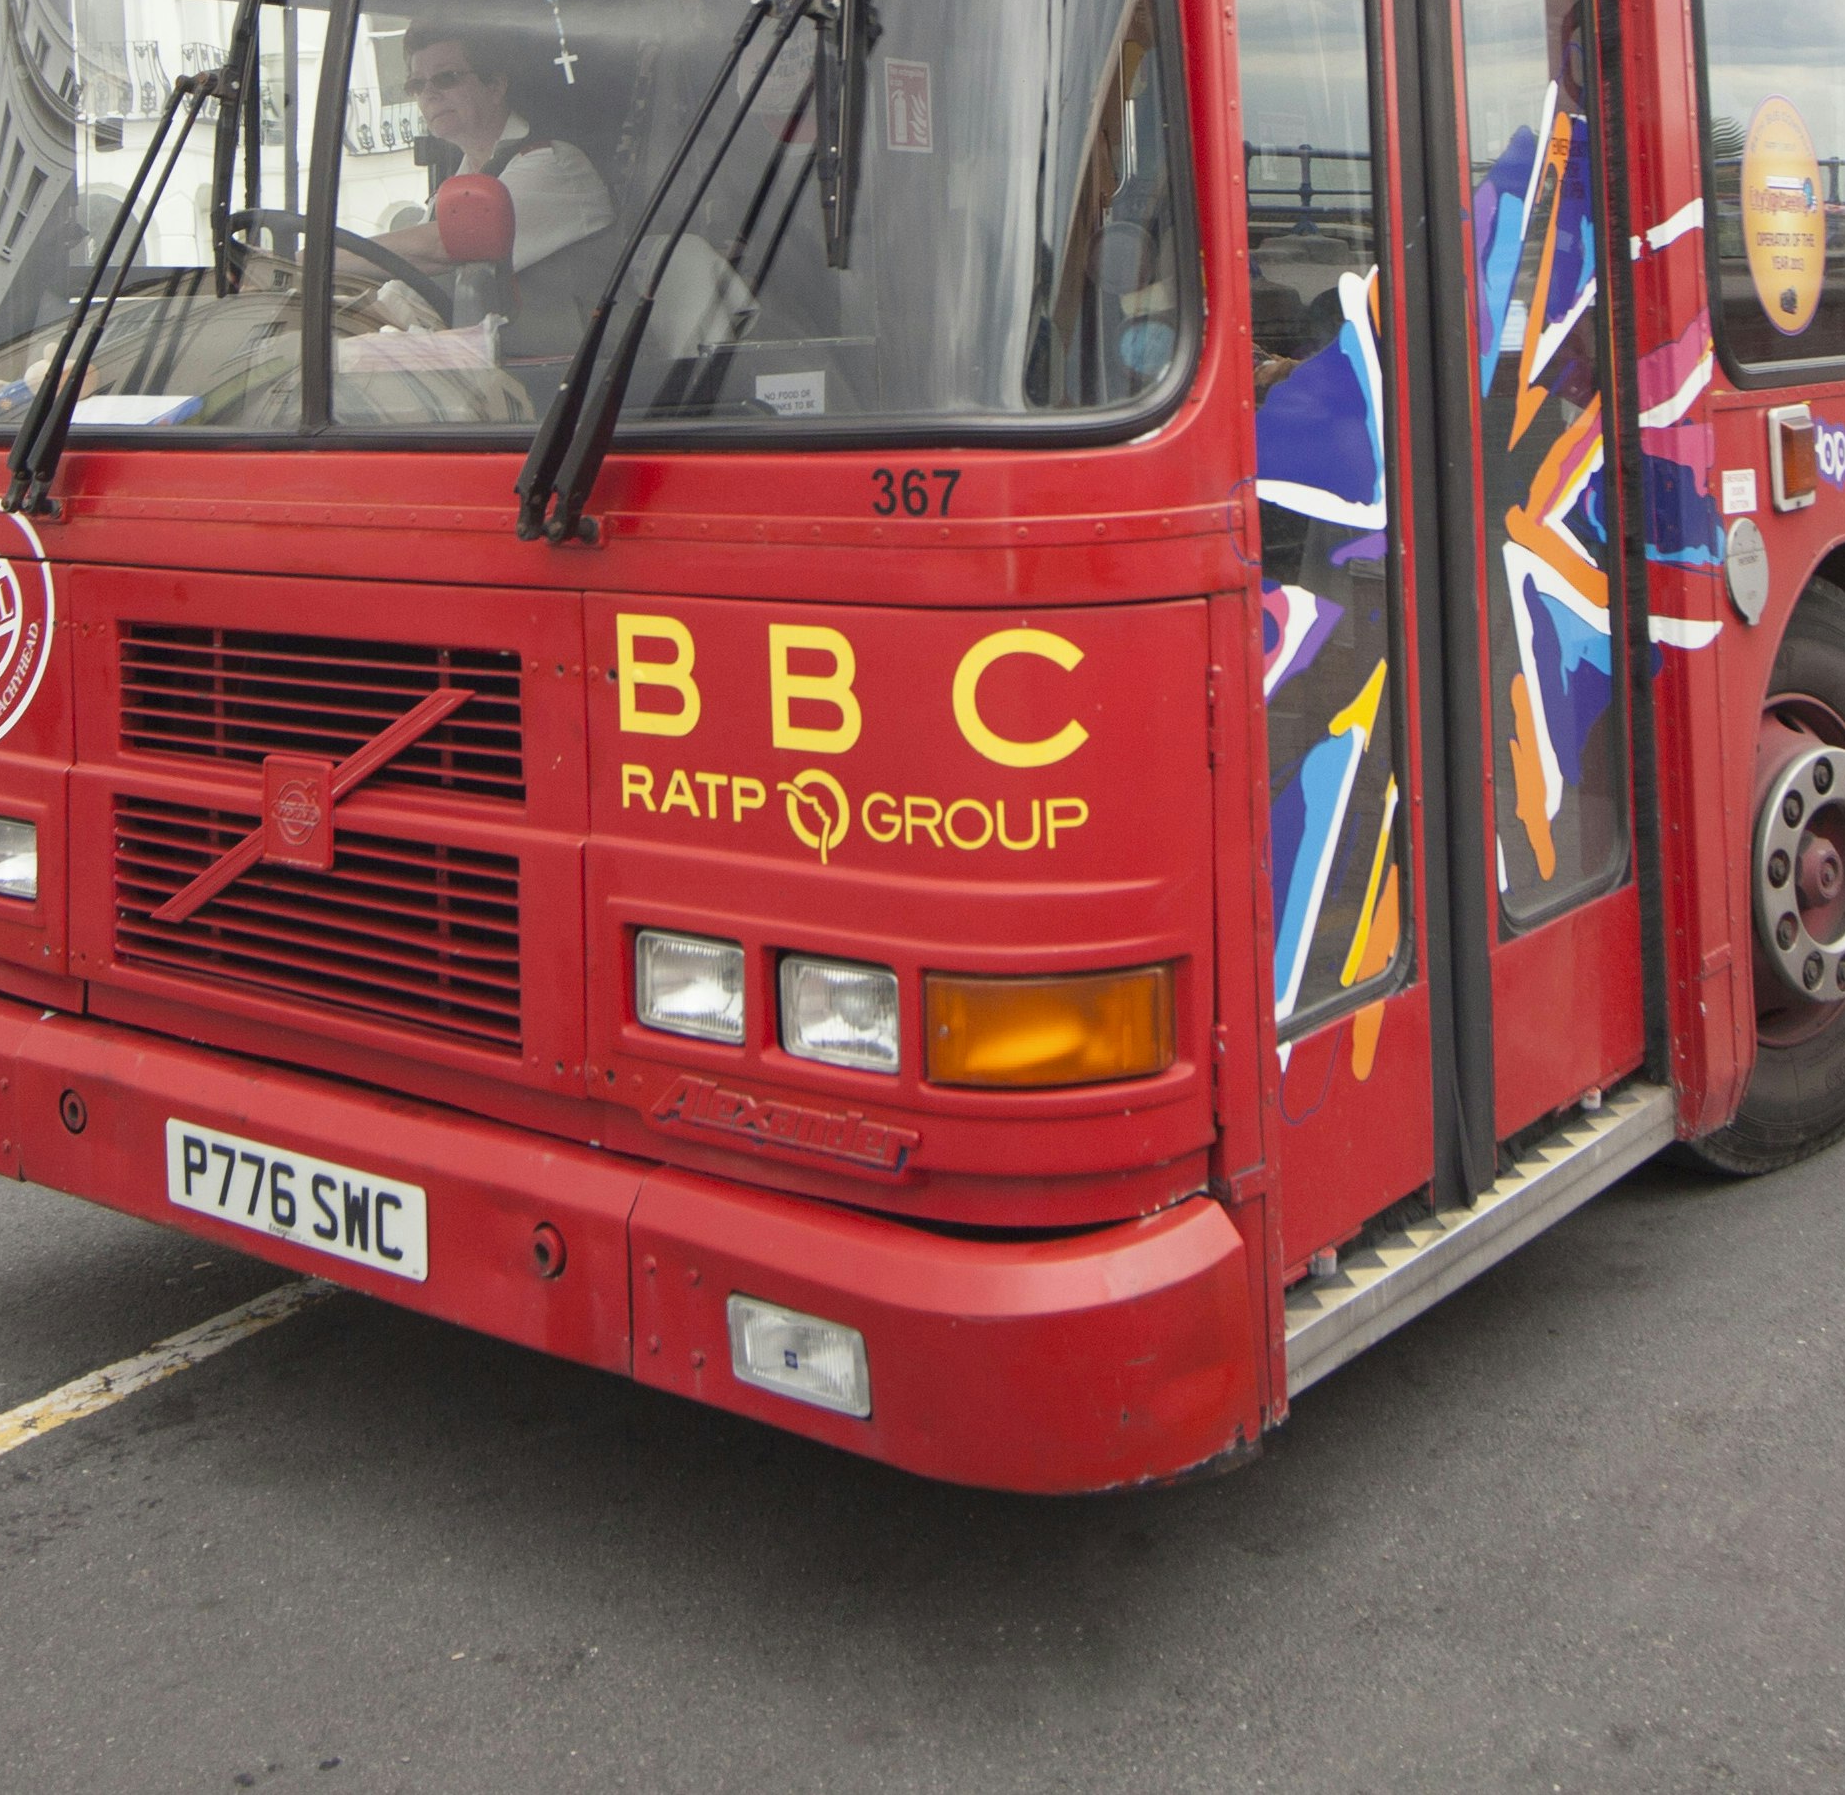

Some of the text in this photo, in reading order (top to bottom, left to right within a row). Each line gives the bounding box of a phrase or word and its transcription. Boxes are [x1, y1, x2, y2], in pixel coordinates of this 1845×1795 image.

[778, 390, 800, 400] FOOD
[871, 469, 961, 517] 367
[622, 764, 1090, 850] RATP GROUP
[650, 1075, 921, 1173] Alexander
[183, 1135, 403, 1261] P776 SWC
